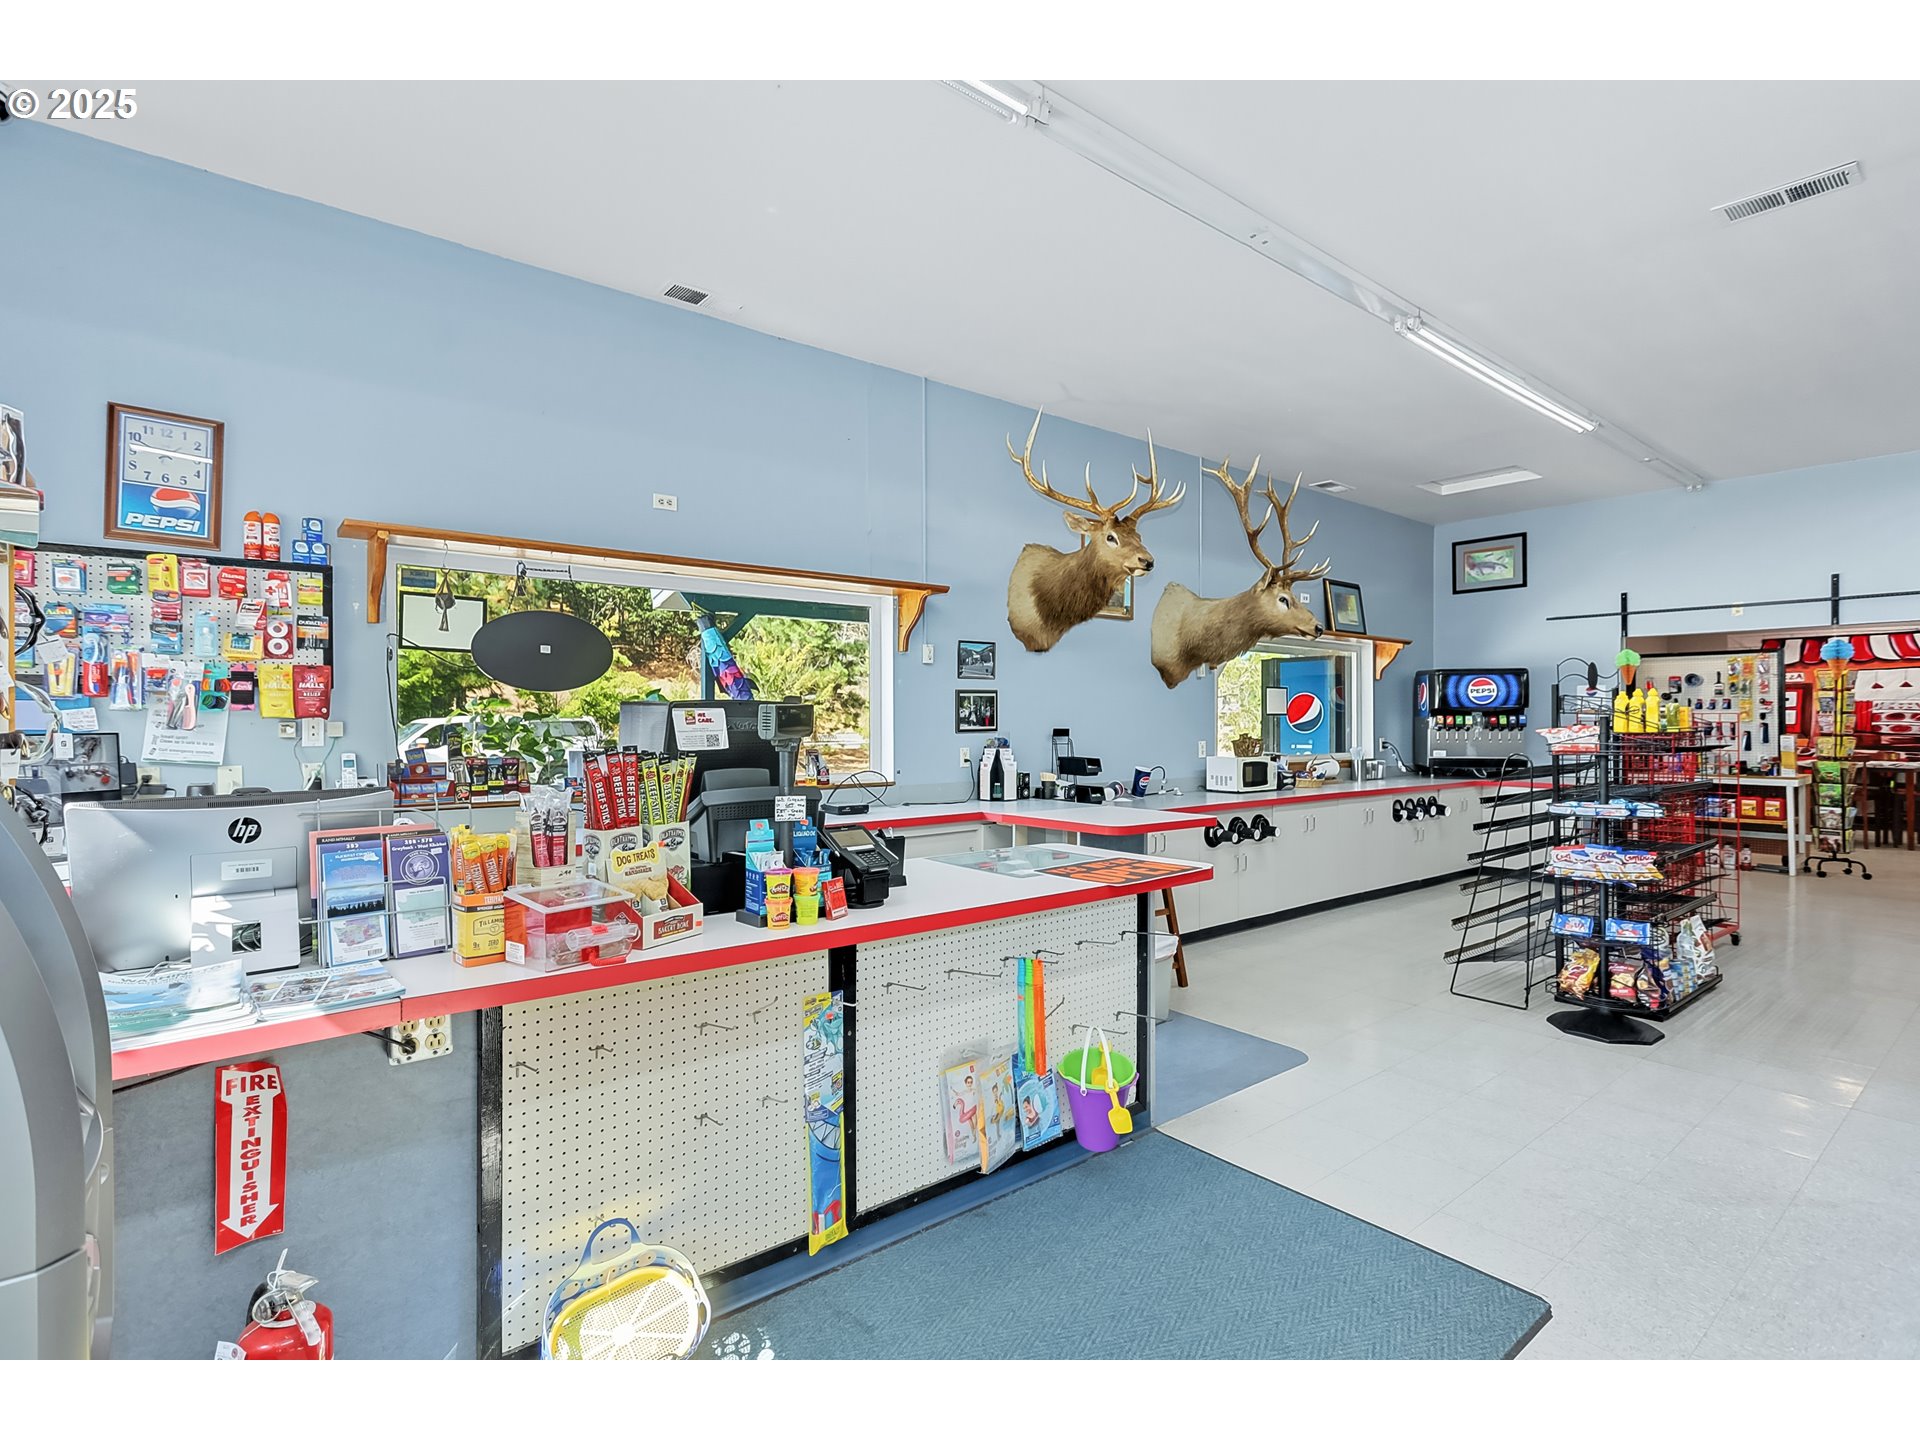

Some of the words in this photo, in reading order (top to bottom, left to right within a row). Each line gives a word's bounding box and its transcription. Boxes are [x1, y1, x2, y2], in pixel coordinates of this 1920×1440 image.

[128, 432, 141, 441] 10
[142, 425, 154, 435] 11
[160, 428, 173, 438] 12
[193, 441, 202, 451] 2
[143, 471, 151, 480] 7
[161, 473, 170, 483] 6
[180, 476, 187, 485] 5
[193, 470, 201, 479] 4
[124, 512, 201, 533] PEPSI
[595, 781, 607, 803] BEEF
[612, 776, 624, 796] BEEF
[626, 776, 635, 797] BEEF
[600, 804, 611, 825] STICK
[616, 797, 627, 818] STICK
[627, 797, 637, 818] STICK
[232, 817, 258, 844] hp
[616, 855, 631, 867] DOG
[633, 848, 656, 863] TREATS
[1070, 862, 1193, 883] OPEN
[226, 1074, 278, 1096] FIRE
[240, 1094, 262, 1228] EXTINGUISHER
